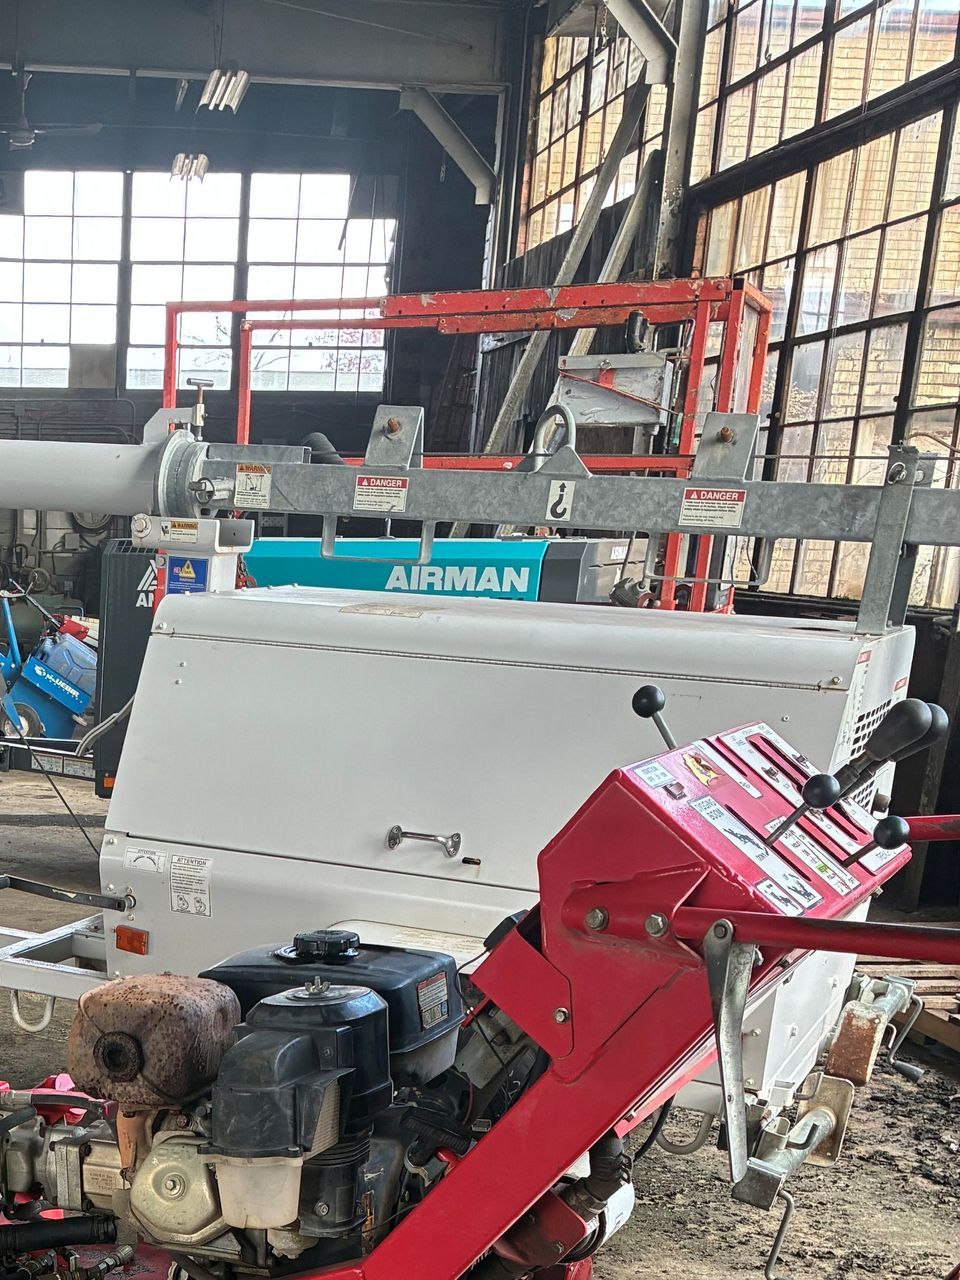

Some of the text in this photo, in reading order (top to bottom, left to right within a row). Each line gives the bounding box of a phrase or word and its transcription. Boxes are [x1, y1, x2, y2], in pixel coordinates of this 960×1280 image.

[370, 478, 402, 487] DANGER
[700, 490, 739, 500] DANGER
[385, 566, 530, 593] AIRMAN
[177, 857, 207, 867] ATTENTION
